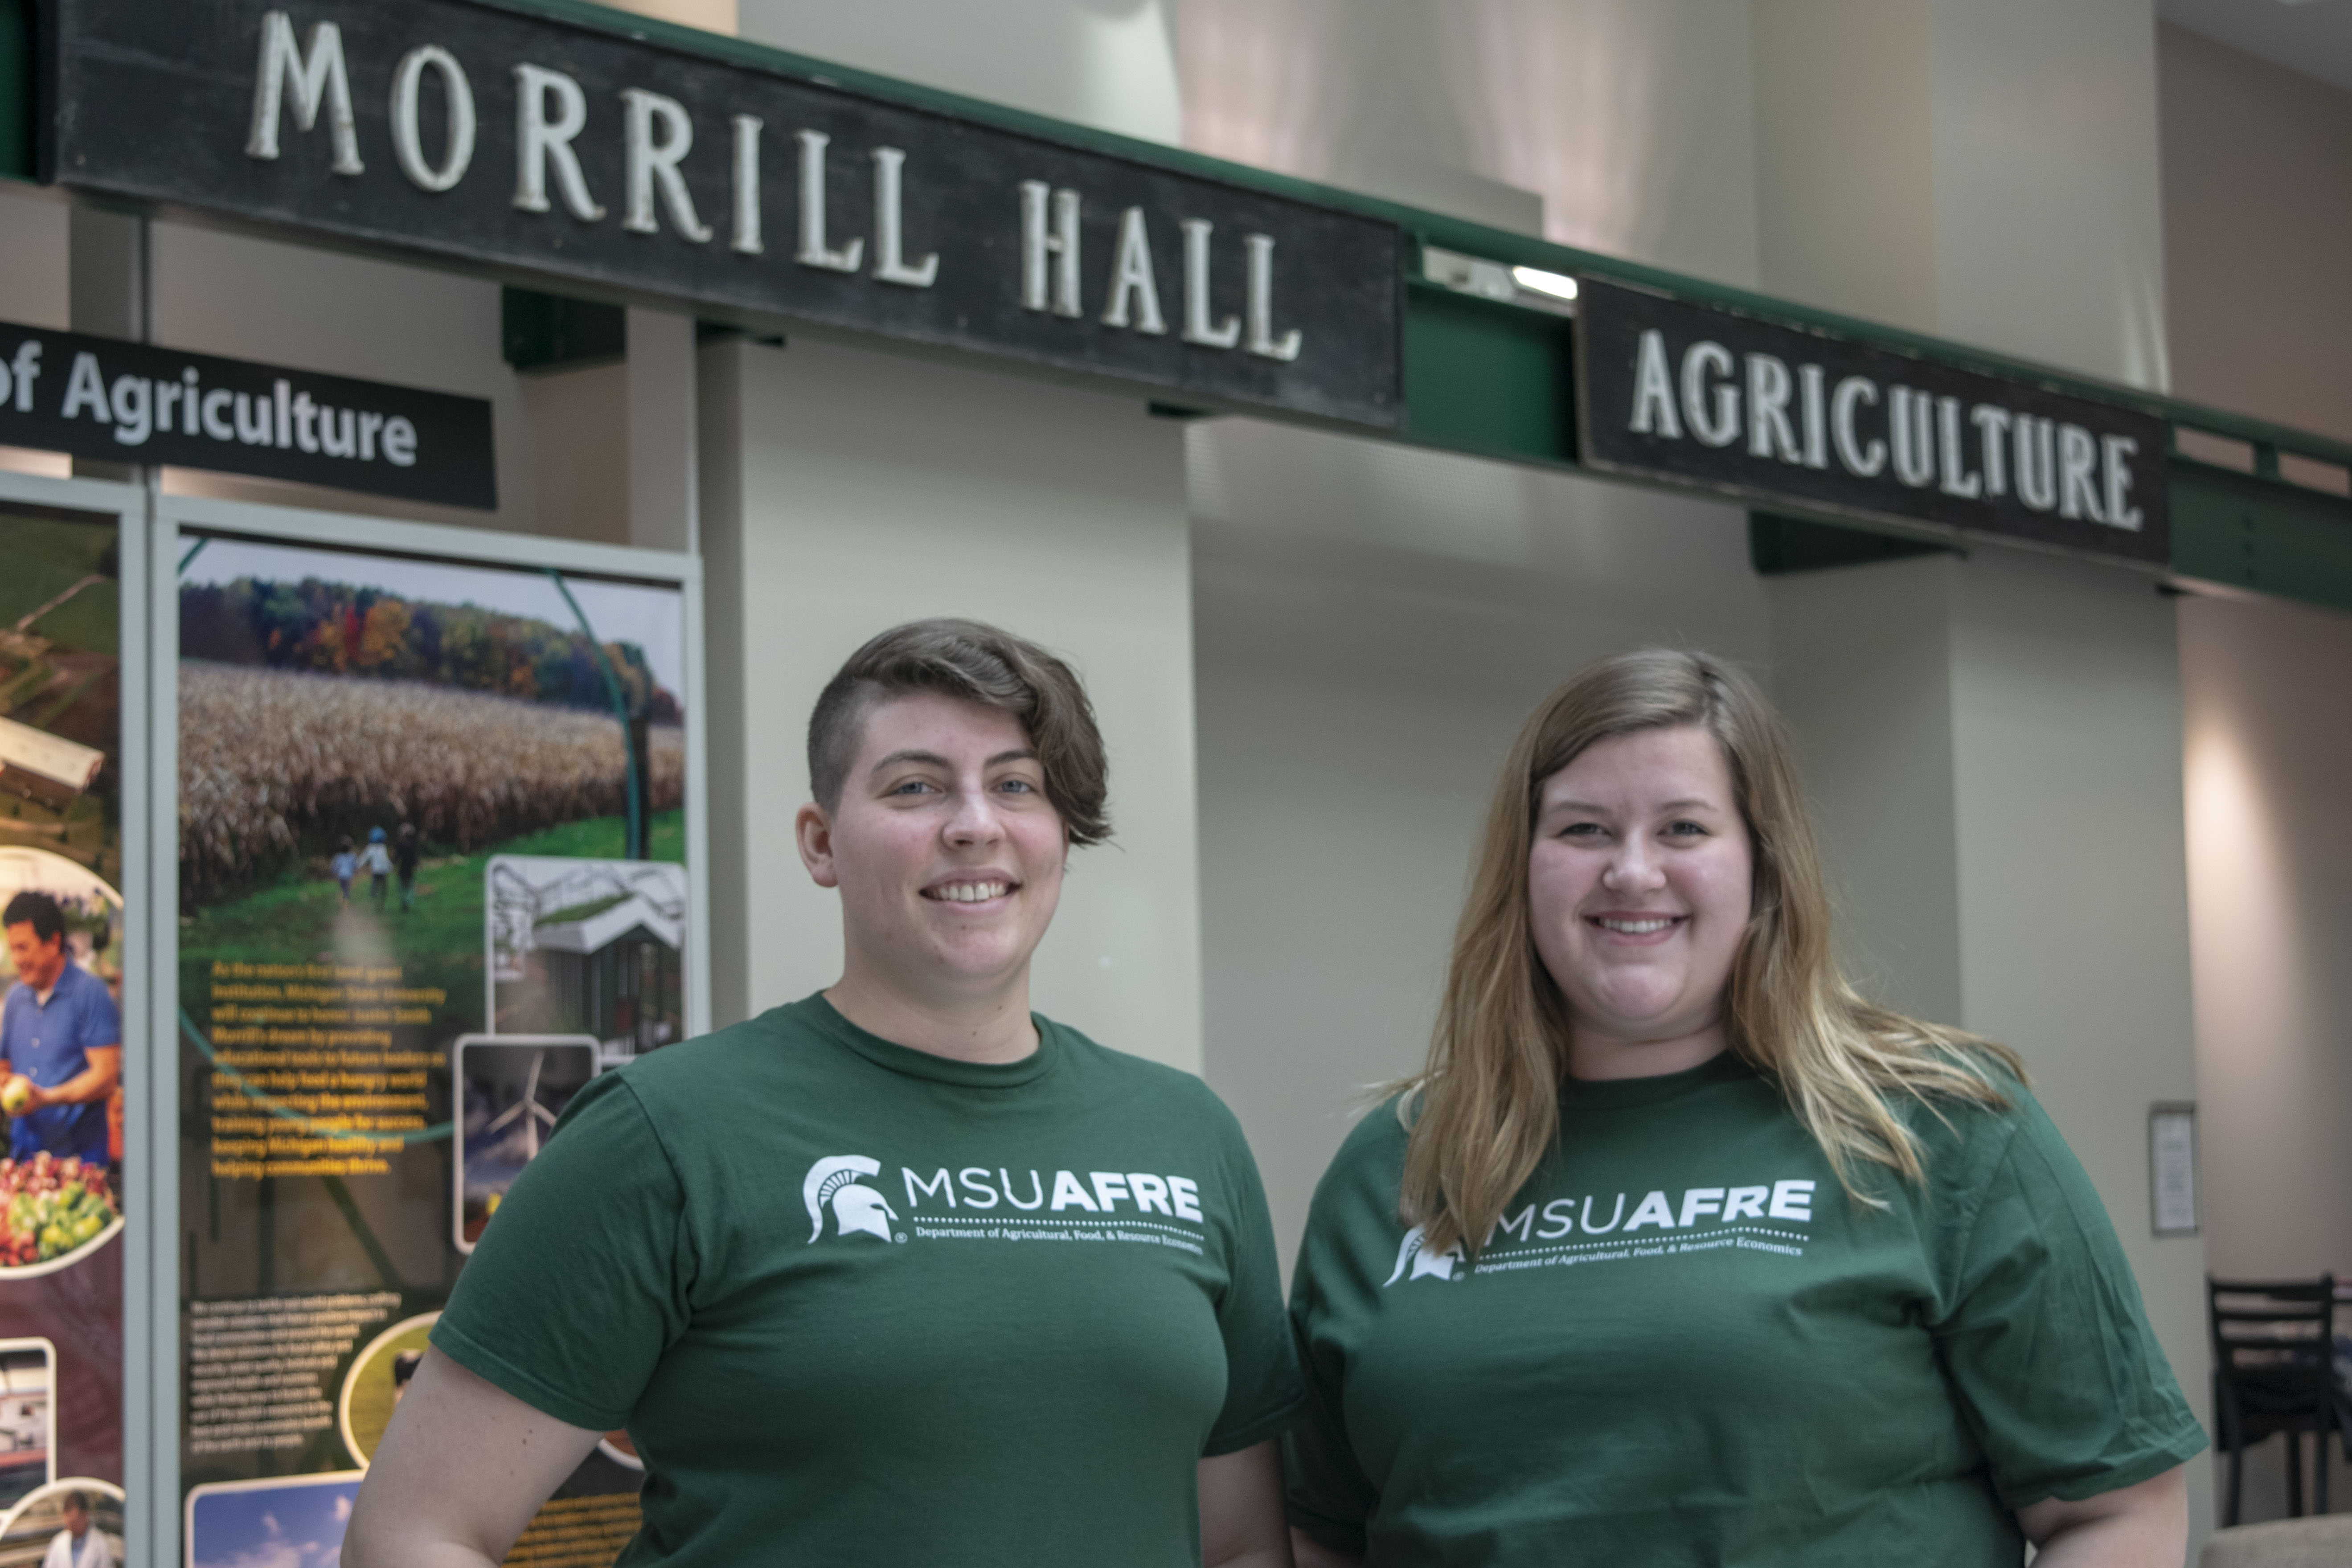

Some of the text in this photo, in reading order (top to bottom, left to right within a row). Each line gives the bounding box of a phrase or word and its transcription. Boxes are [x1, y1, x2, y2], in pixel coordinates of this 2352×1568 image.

[245, 10, 1302, 362] MORRILL HALL
[62, 351, 417, 467] Agriculture
[1628, 328, 2142, 532] AGRICULTURE
[901, 1167, 1203, 1224] MSUAFRE
[916, 1226, 984, 1239] Department
[987, 1228, 1000, 1238] of
[1106, 1230, 1116, 1240] &
[1117, 1230, 1160, 1244] Resource
[1475, 1256, 1542, 1273] Department
[1544, 1253, 1558, 1265] of
[1667, 1245, 1678, 1254] &
[1680, 1238, 1734, 1253] Resource
[1736, 1237, 1803, 1257] Economics
